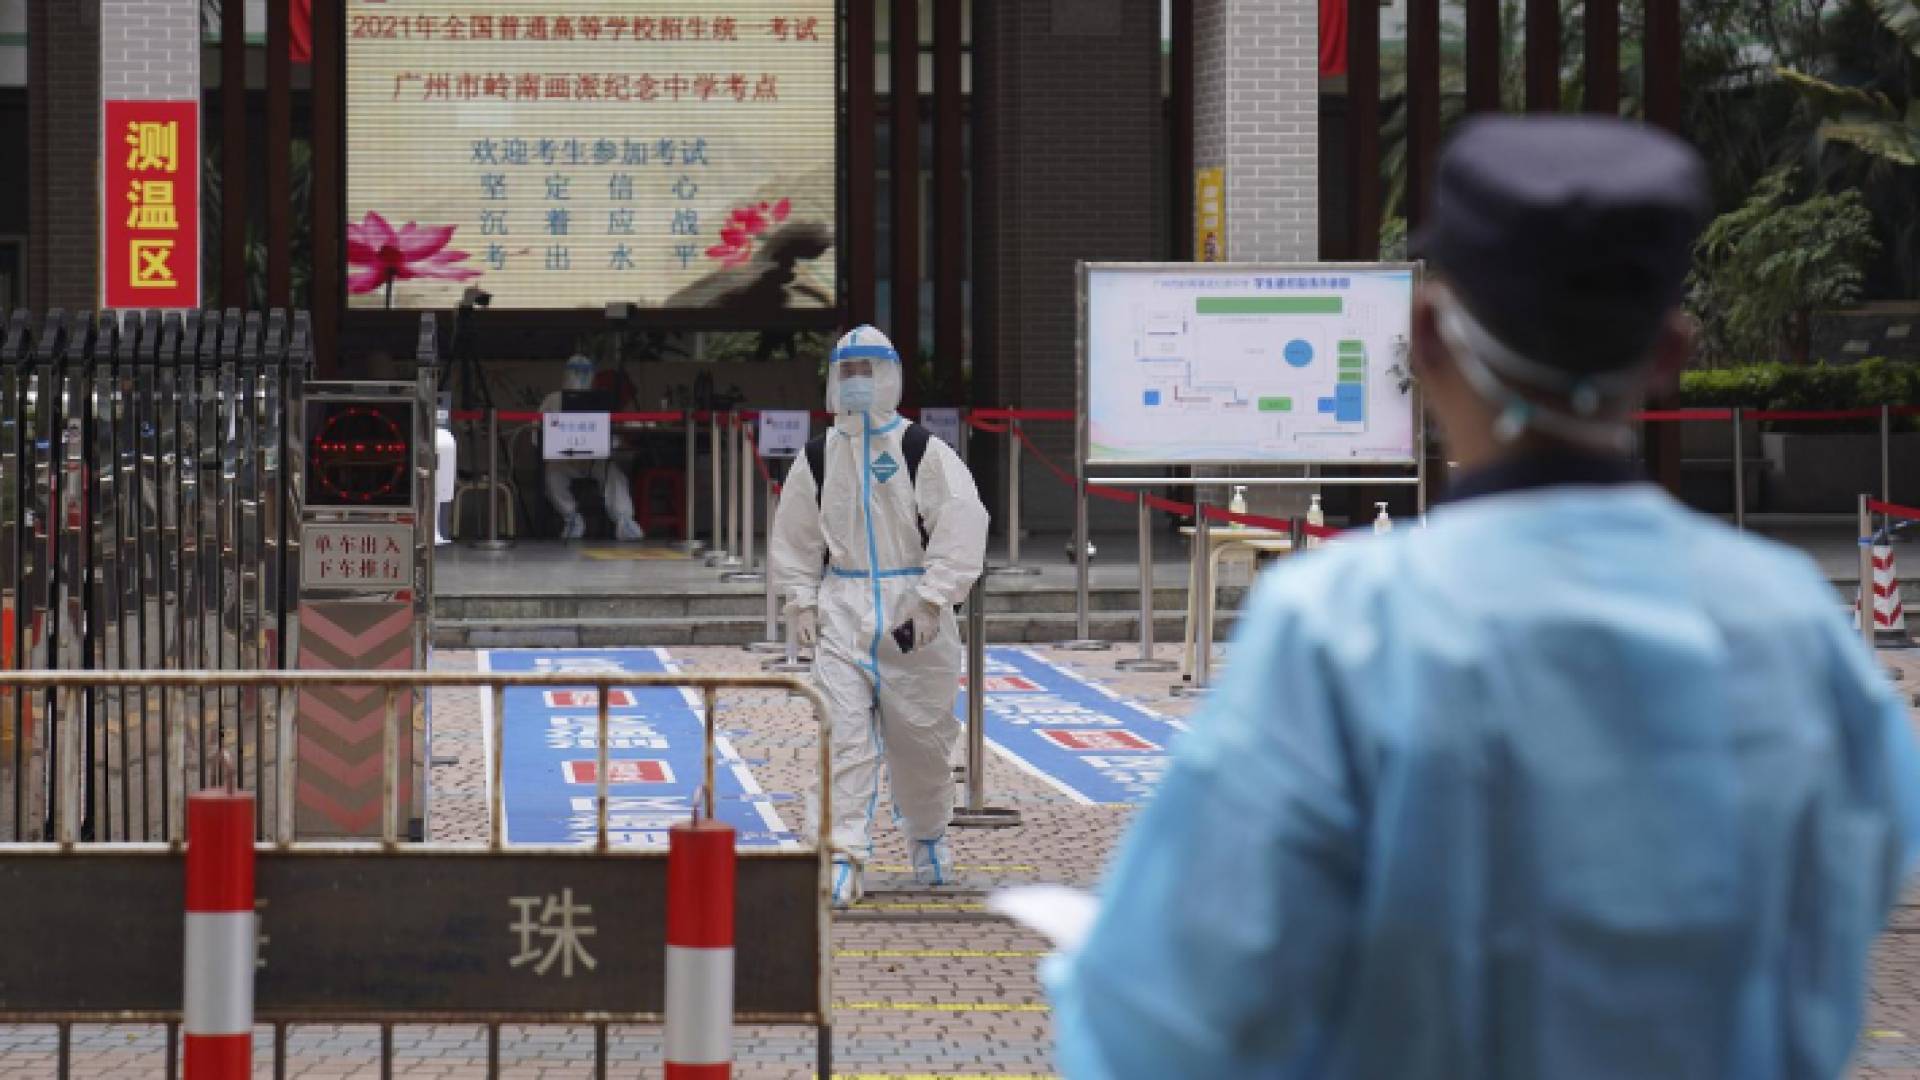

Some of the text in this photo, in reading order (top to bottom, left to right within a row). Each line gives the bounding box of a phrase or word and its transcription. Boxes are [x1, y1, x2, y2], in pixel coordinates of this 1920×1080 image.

[353, 15, 818, 41] 2021年全国普通高等学校招生统考试
[393, 72, 778, 102] 广州市岭南画派纪念中学考点
[472, 136, 708, 165] 欢迎考生参加考试
[124, 120, 179, 289] 测温区
[314, 533, 401, 556] 单车出入
[315, 557, 401, 579] 下车推行
[508, 886, 598, 978] 珠
